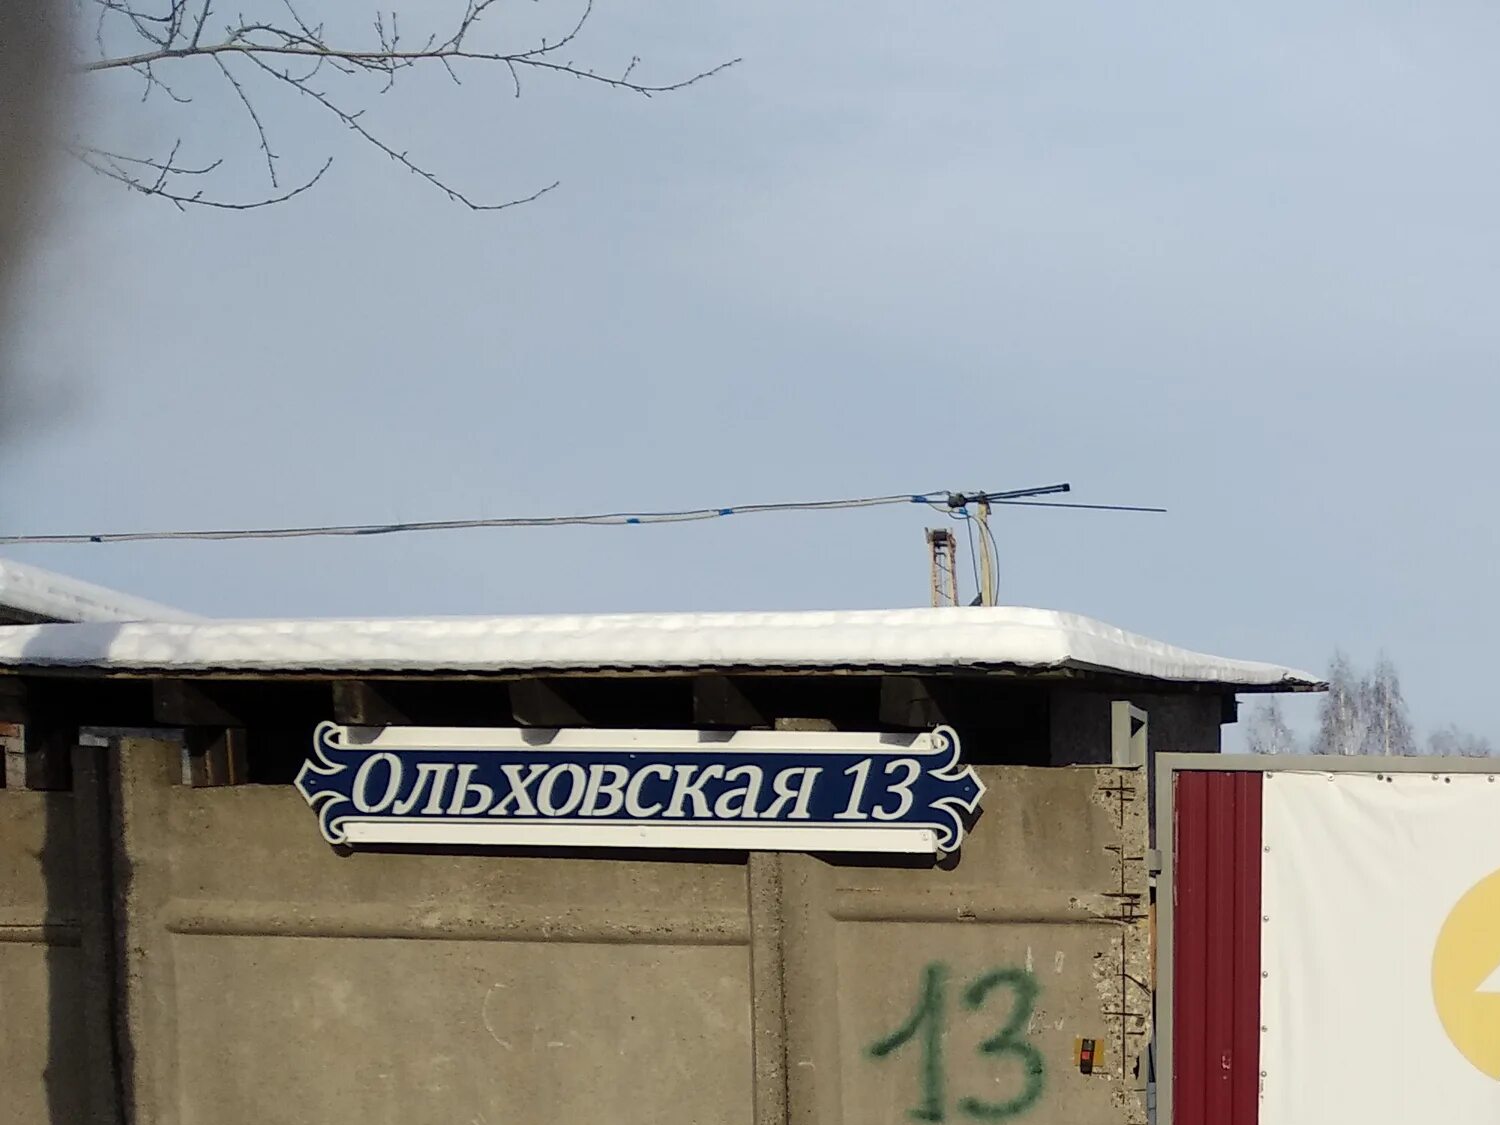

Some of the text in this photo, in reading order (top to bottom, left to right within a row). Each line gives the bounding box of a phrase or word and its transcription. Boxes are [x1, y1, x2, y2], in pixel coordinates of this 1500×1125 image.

[352, 752, 921, 821] Ольховская 13
[868, 962, 1043, 1124] 13
